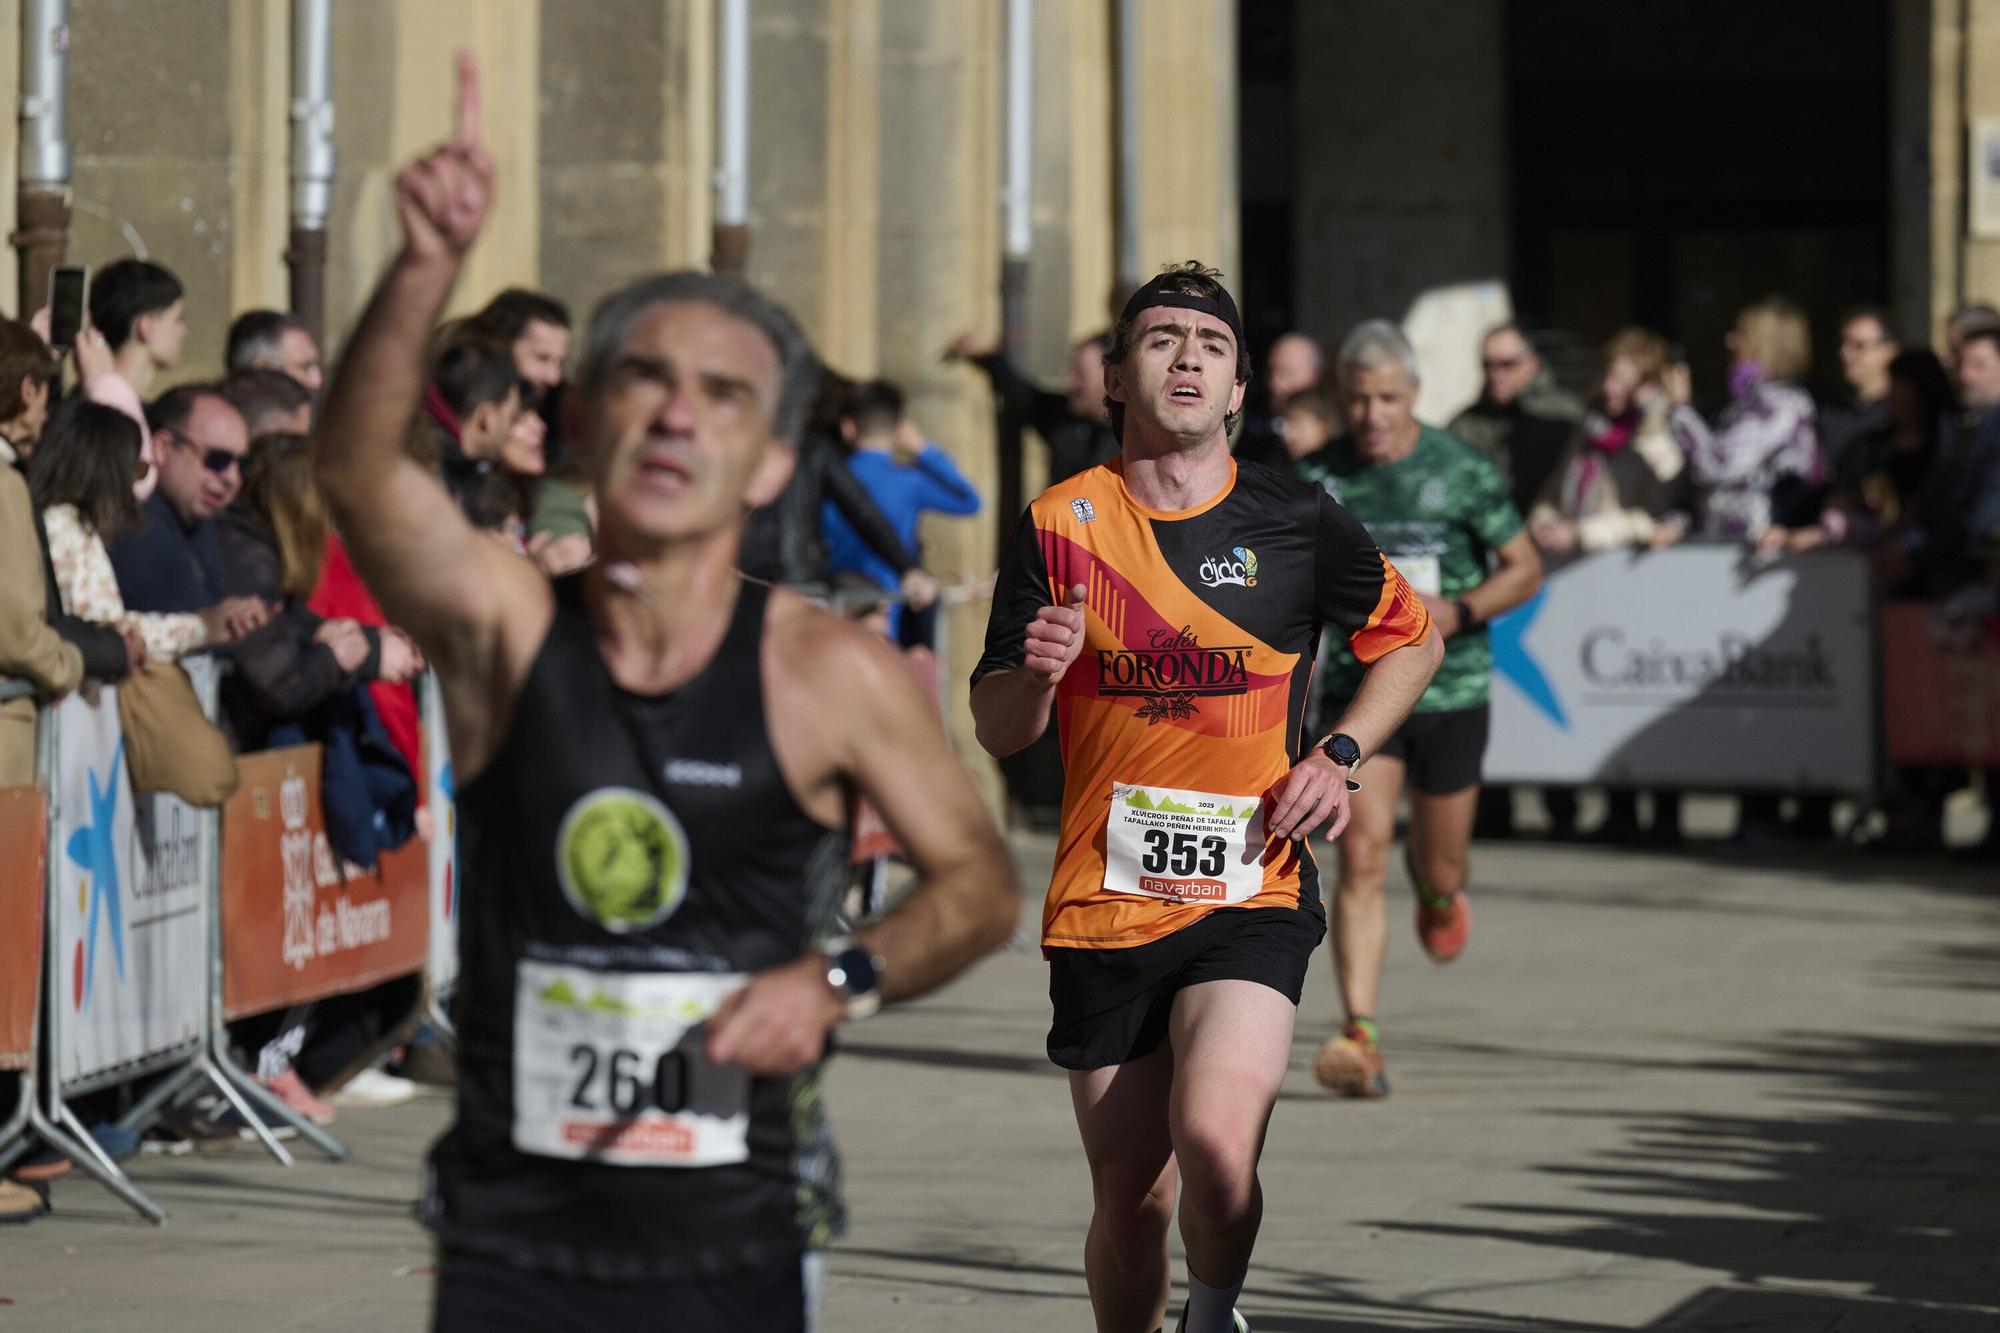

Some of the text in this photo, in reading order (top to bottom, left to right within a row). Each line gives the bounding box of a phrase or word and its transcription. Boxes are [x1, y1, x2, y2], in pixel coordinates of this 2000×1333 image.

[1147, 624, 1198, 650] Cafés
[1198, 801, 1215, 809] 2025
[1124, 816, 1165, 828] TAFALLAKO
[1207, 818, 1236, 826] TAFALLA
[1142, 829, 1227, 877] 353
[1144, 878, 1222, 896] navarban
[570, 1044, 688, 1115] 260
